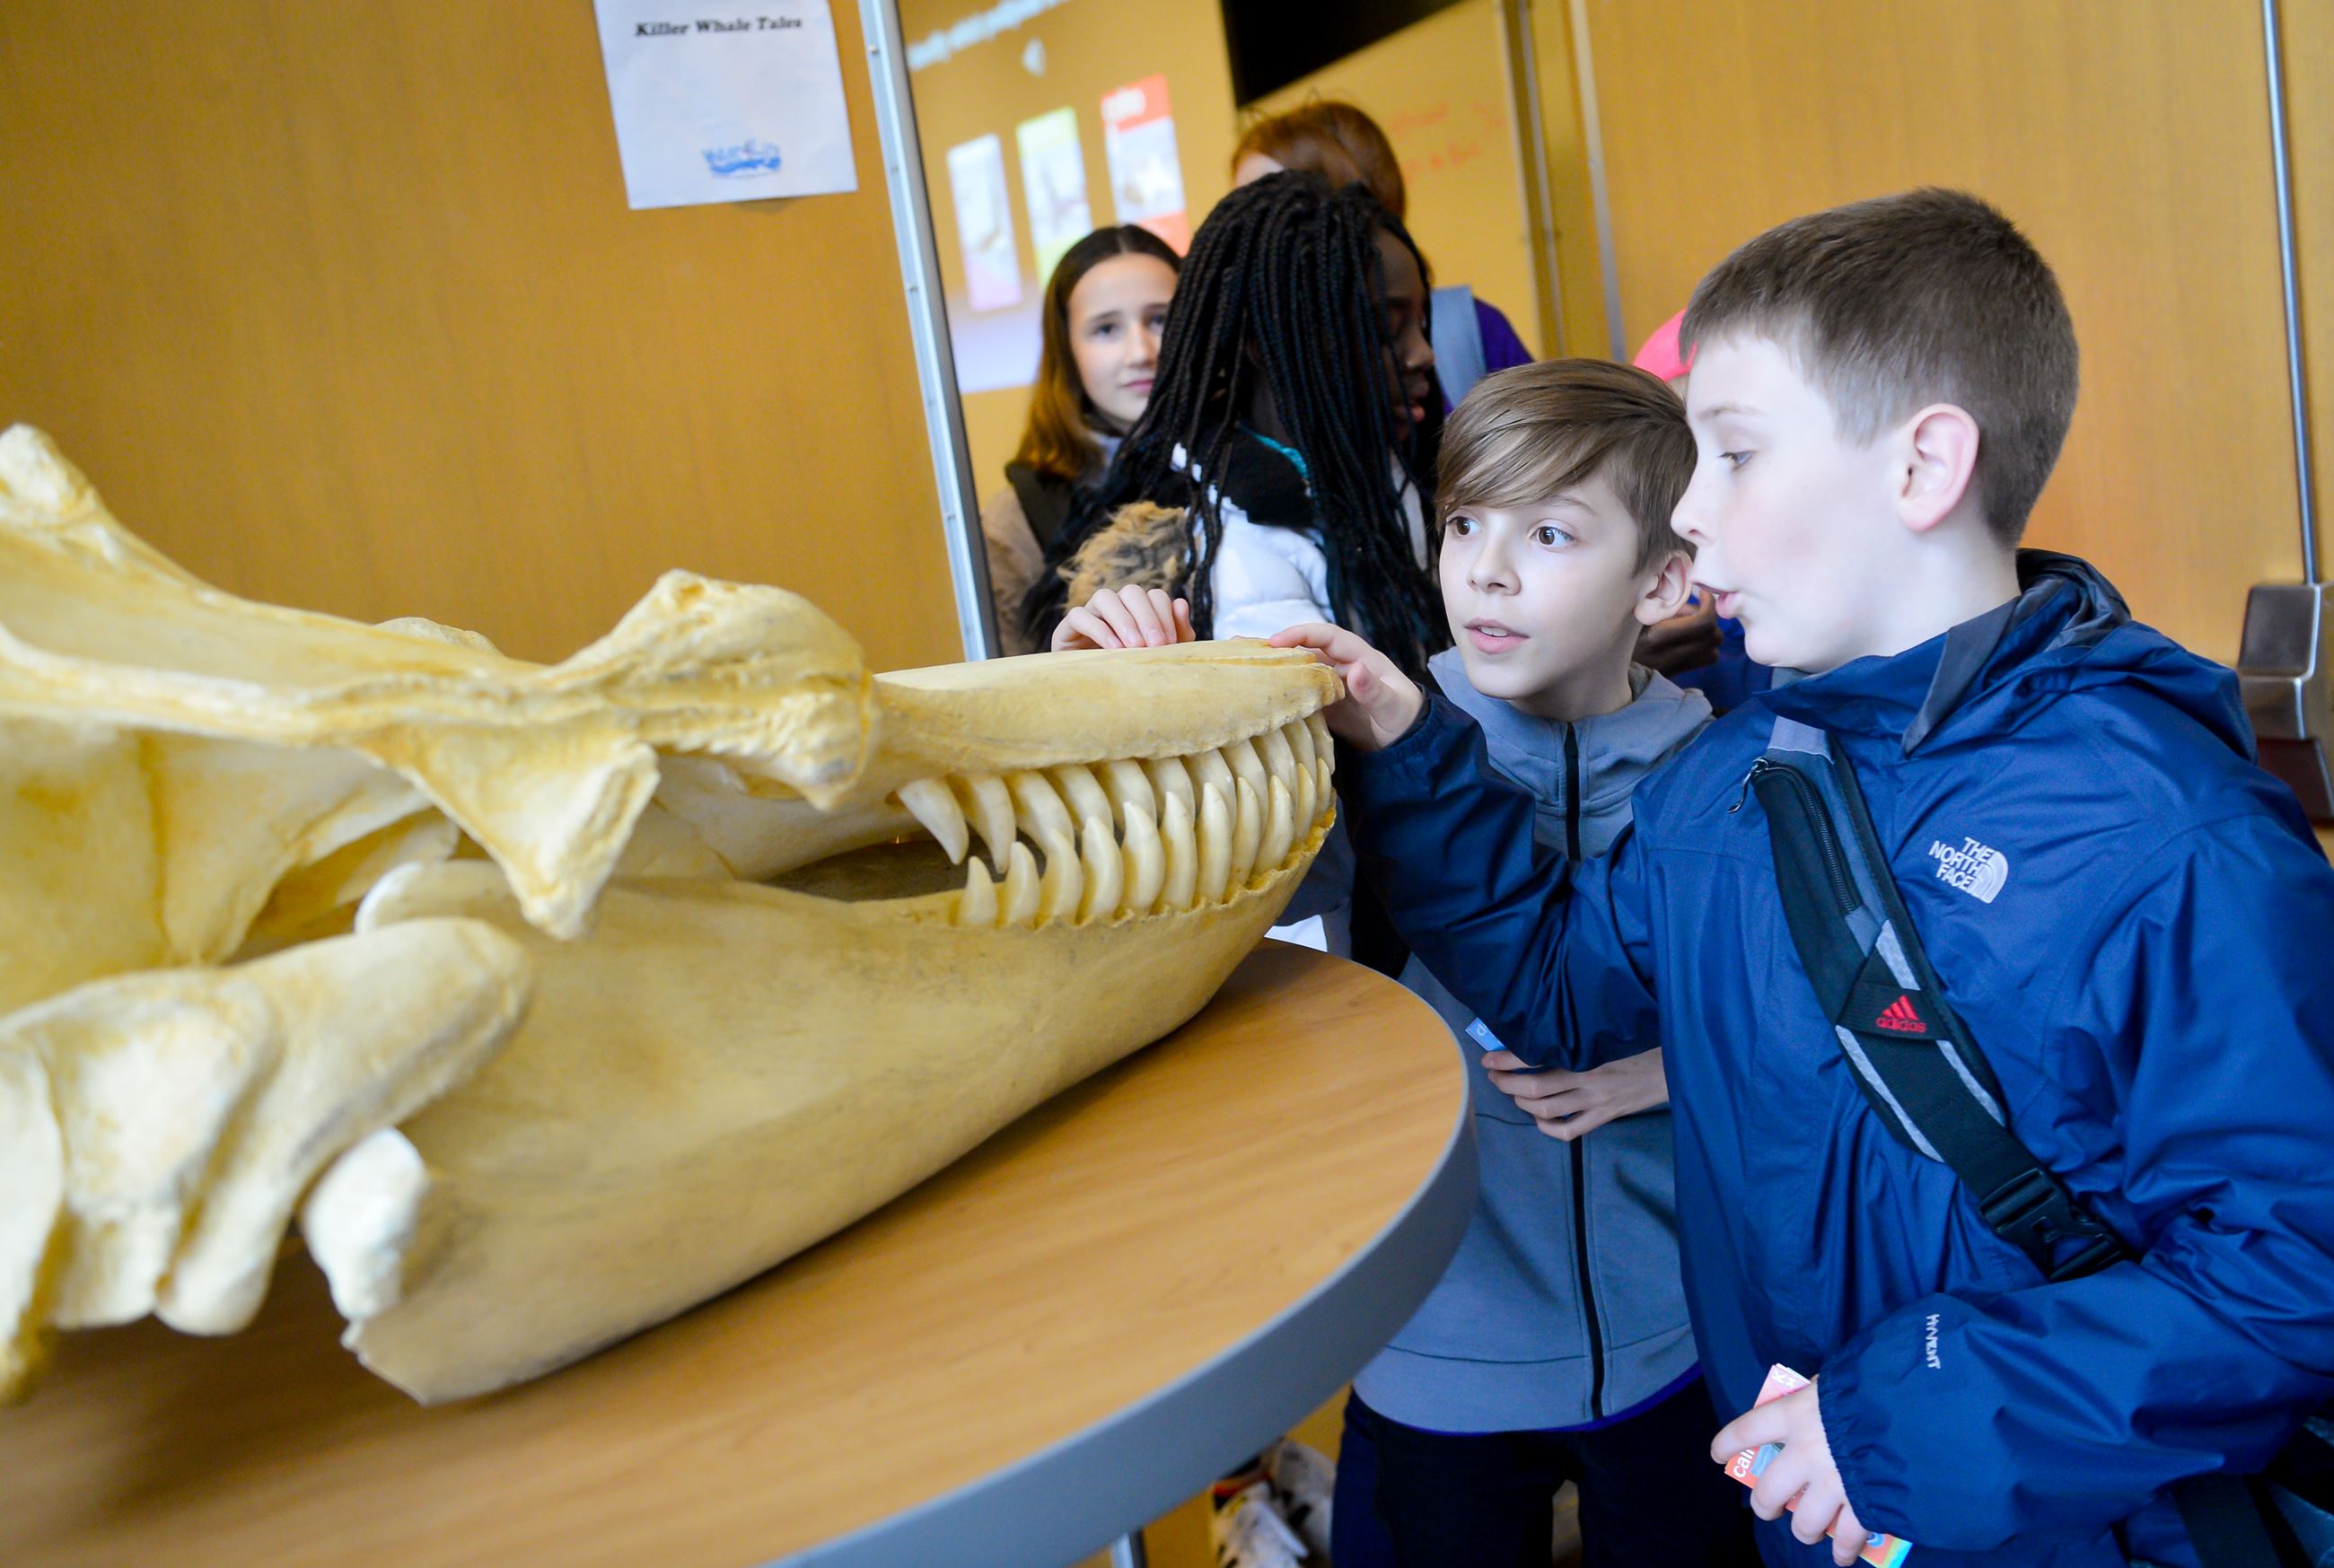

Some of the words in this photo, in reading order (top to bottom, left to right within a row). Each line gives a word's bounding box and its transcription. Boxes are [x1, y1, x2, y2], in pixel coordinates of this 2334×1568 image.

[636, 22, 689, 37] Killer
[696, 18, 750, 33] Whale
[757, 15, 803, 30] Tales
[1928, 840, 1984, 877] NORTH
[1961, 837, 1995, 863] THE
[1936, 863, 1977, 891] FACE
[1876, 1017, 1926, 1033] adidas
